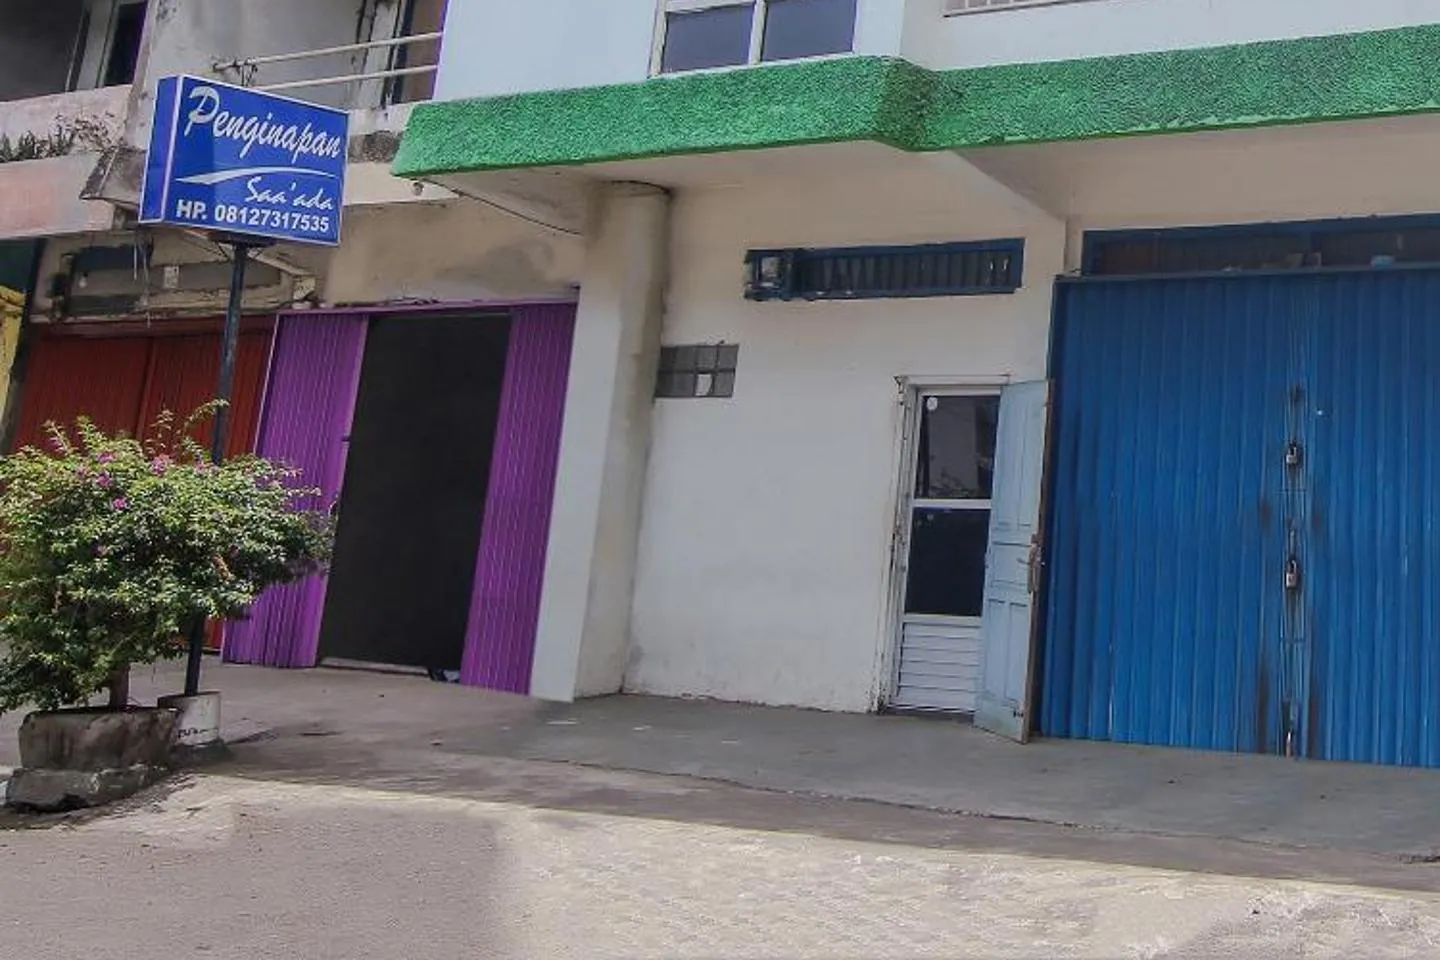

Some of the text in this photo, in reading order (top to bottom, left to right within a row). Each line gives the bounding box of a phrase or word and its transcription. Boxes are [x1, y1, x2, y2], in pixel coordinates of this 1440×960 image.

[184, 86, 341, 163] Penginapan
[244, 176, 334, 210] Saa'ada
[176, 199, 330, 232] HP. 08127317535
